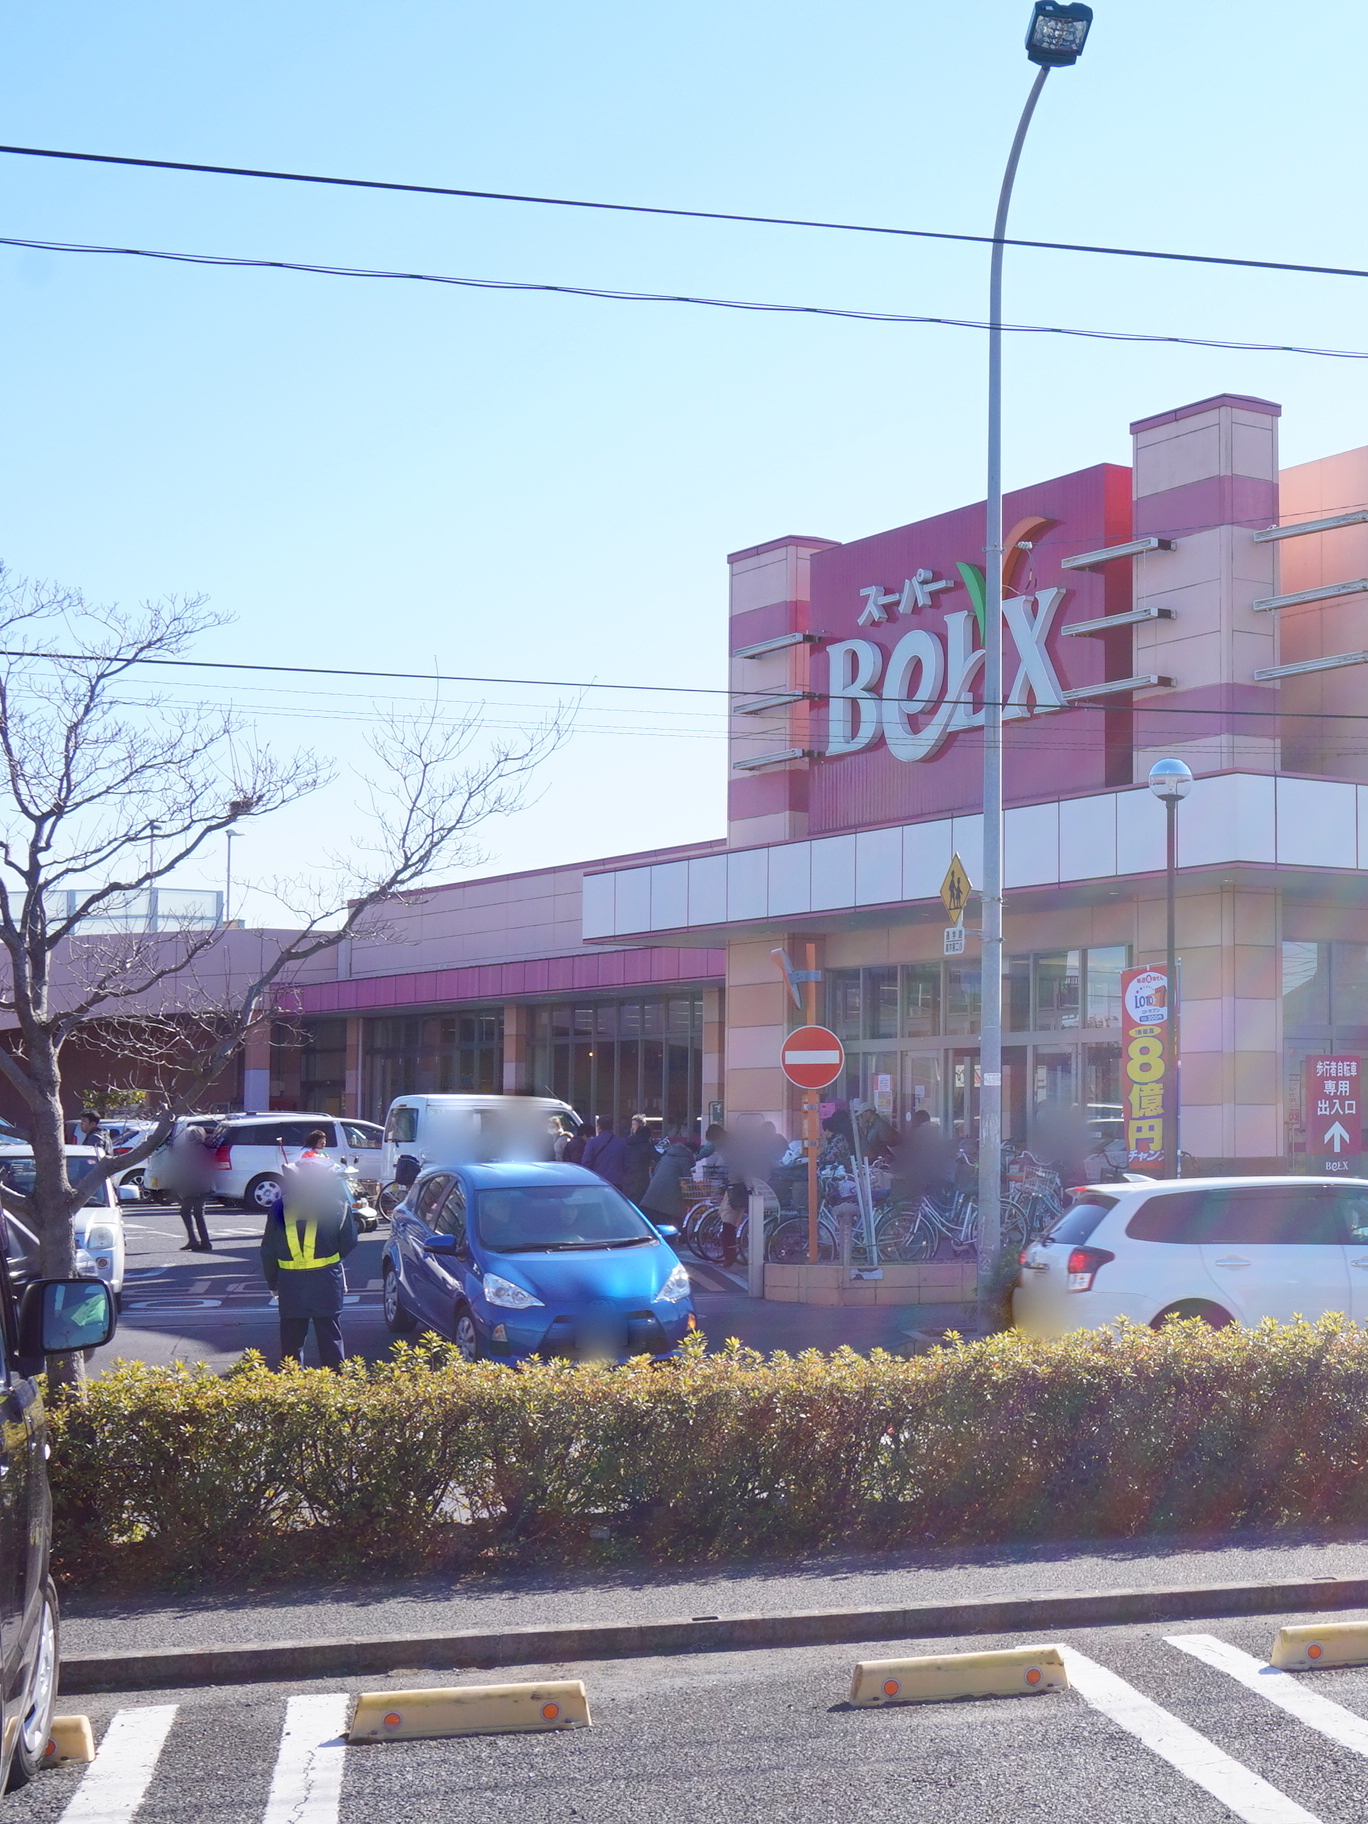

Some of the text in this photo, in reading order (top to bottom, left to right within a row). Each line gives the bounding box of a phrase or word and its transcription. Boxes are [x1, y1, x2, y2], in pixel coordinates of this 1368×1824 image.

[857, 568, 955, 626] スーパー
[1316, 1061, 1357, 1077] 歩行者自転車
[1126, 1036, 1165, 1151] 8億円
[1324, 1080, 1350, 1096] 専用
[1317, 1100, 1356, 1115] 出入口
